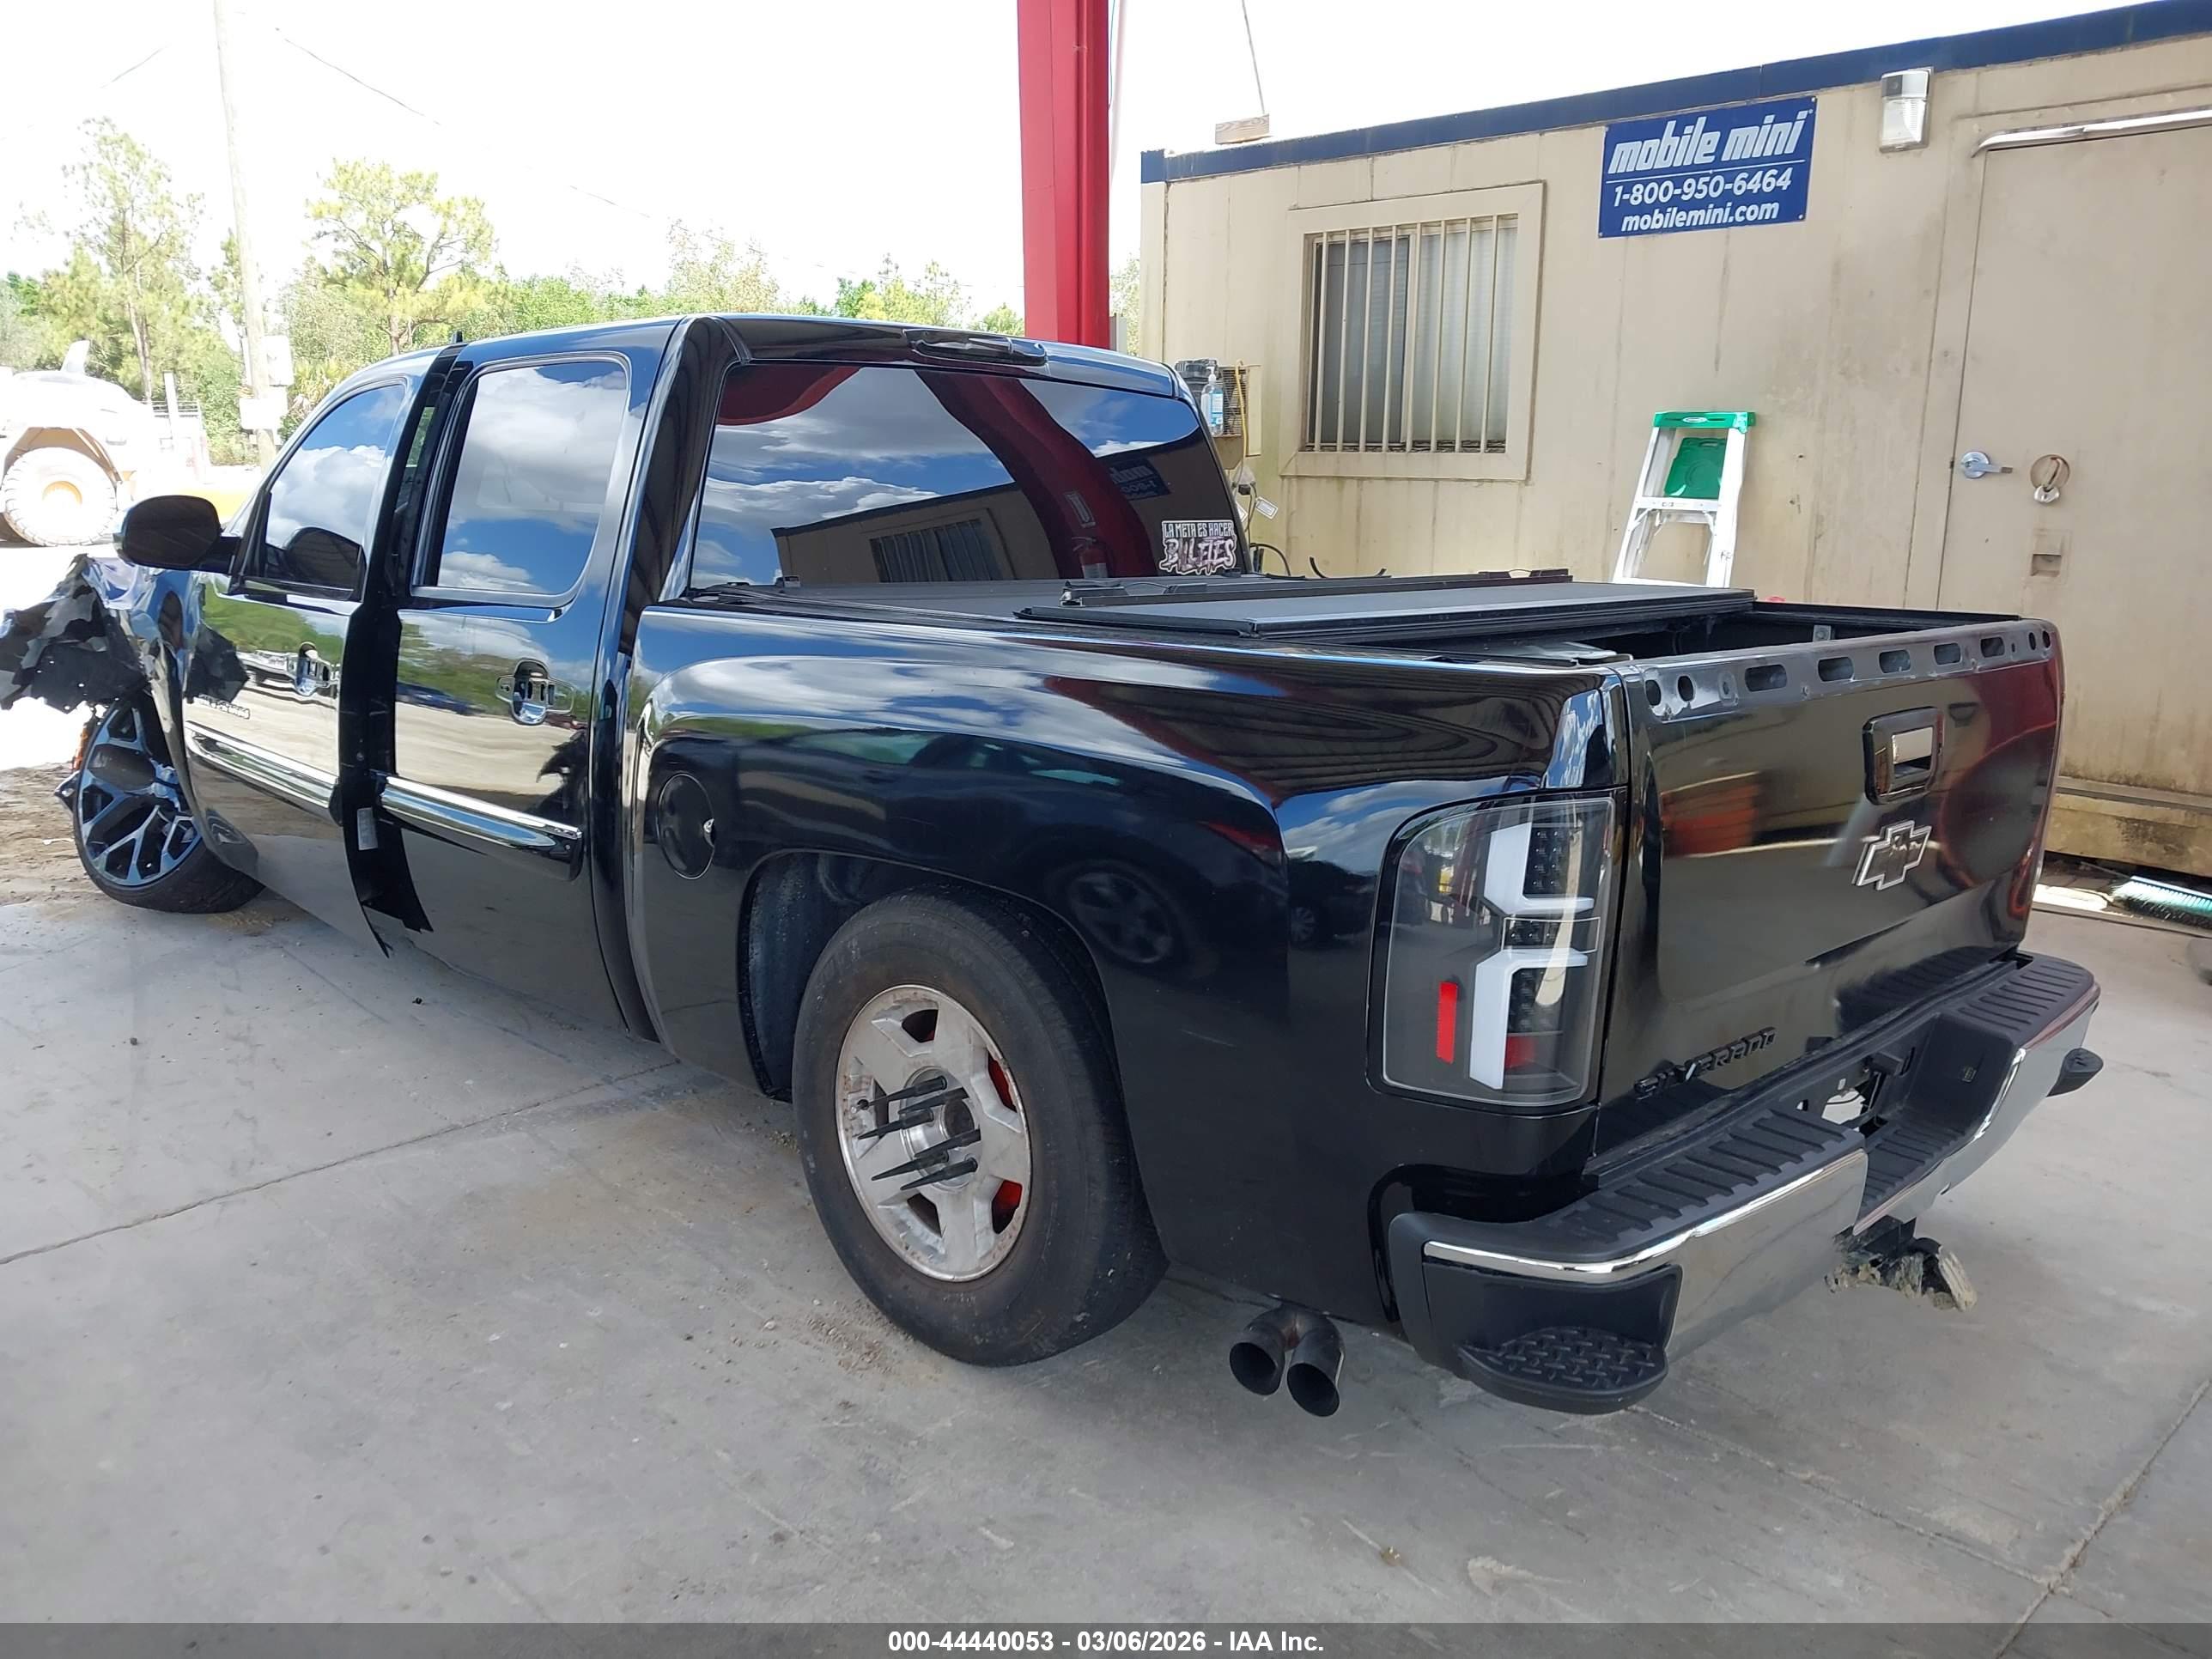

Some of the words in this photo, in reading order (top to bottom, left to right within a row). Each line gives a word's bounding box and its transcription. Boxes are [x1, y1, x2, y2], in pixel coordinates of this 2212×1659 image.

[1607, 117, 1721, 173] mobile
[1721, 110, 1809, 161] mini
[1613, 167, 1793, 207] 1-800-950-6464
[1621, 201, 1780, 231] mobilemini.com
[1164, 523, 1174, 538] LA
[1175, 523, 1196, 538] META
[1197, 523, 1207, 538] ES
[1208, 522, 1232, 537] HACER
